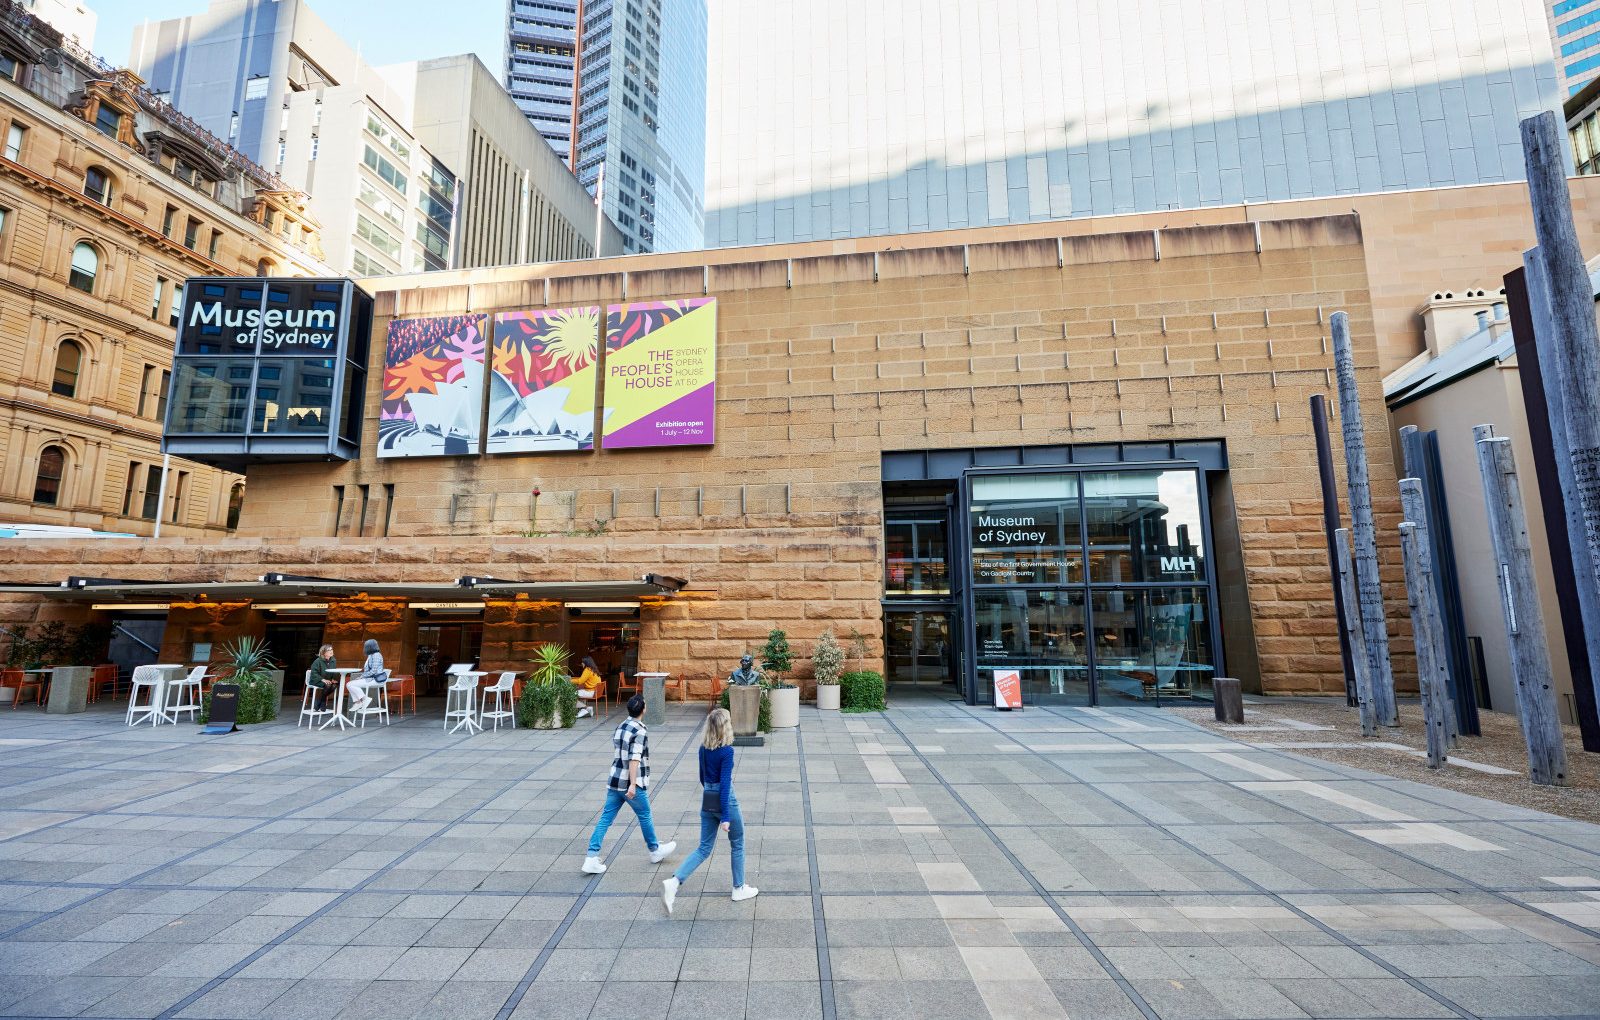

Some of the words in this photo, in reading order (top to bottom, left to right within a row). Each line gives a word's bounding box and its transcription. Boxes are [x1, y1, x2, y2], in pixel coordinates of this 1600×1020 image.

[189, 301, 336, 328] Museum
[236, 328, 258, 344] of
[262, 328, 333, 349] Sydney
[648, 349, 673, 361] THE
[675, 348, 708, 356] SYDNEY
[675, 358, 703, 367] OPERA
[611, 363, 673, 377] PEOPLE'S
[675, 368, 704, 377] HOUSE
[625, 376, 673, 390] HOUSE
[686, 378, 698, 386] 50
[655, 420, 687, 428] Exhibition
[687, 420, 704, 428] open
[664, 429, 678, 437] July
[978, 515, 1035, 527] Museum
[979, 530, 994, 542] of
[996, 530, 1046, 544] Sydney
[1160, 556, 1196, 571] MH
